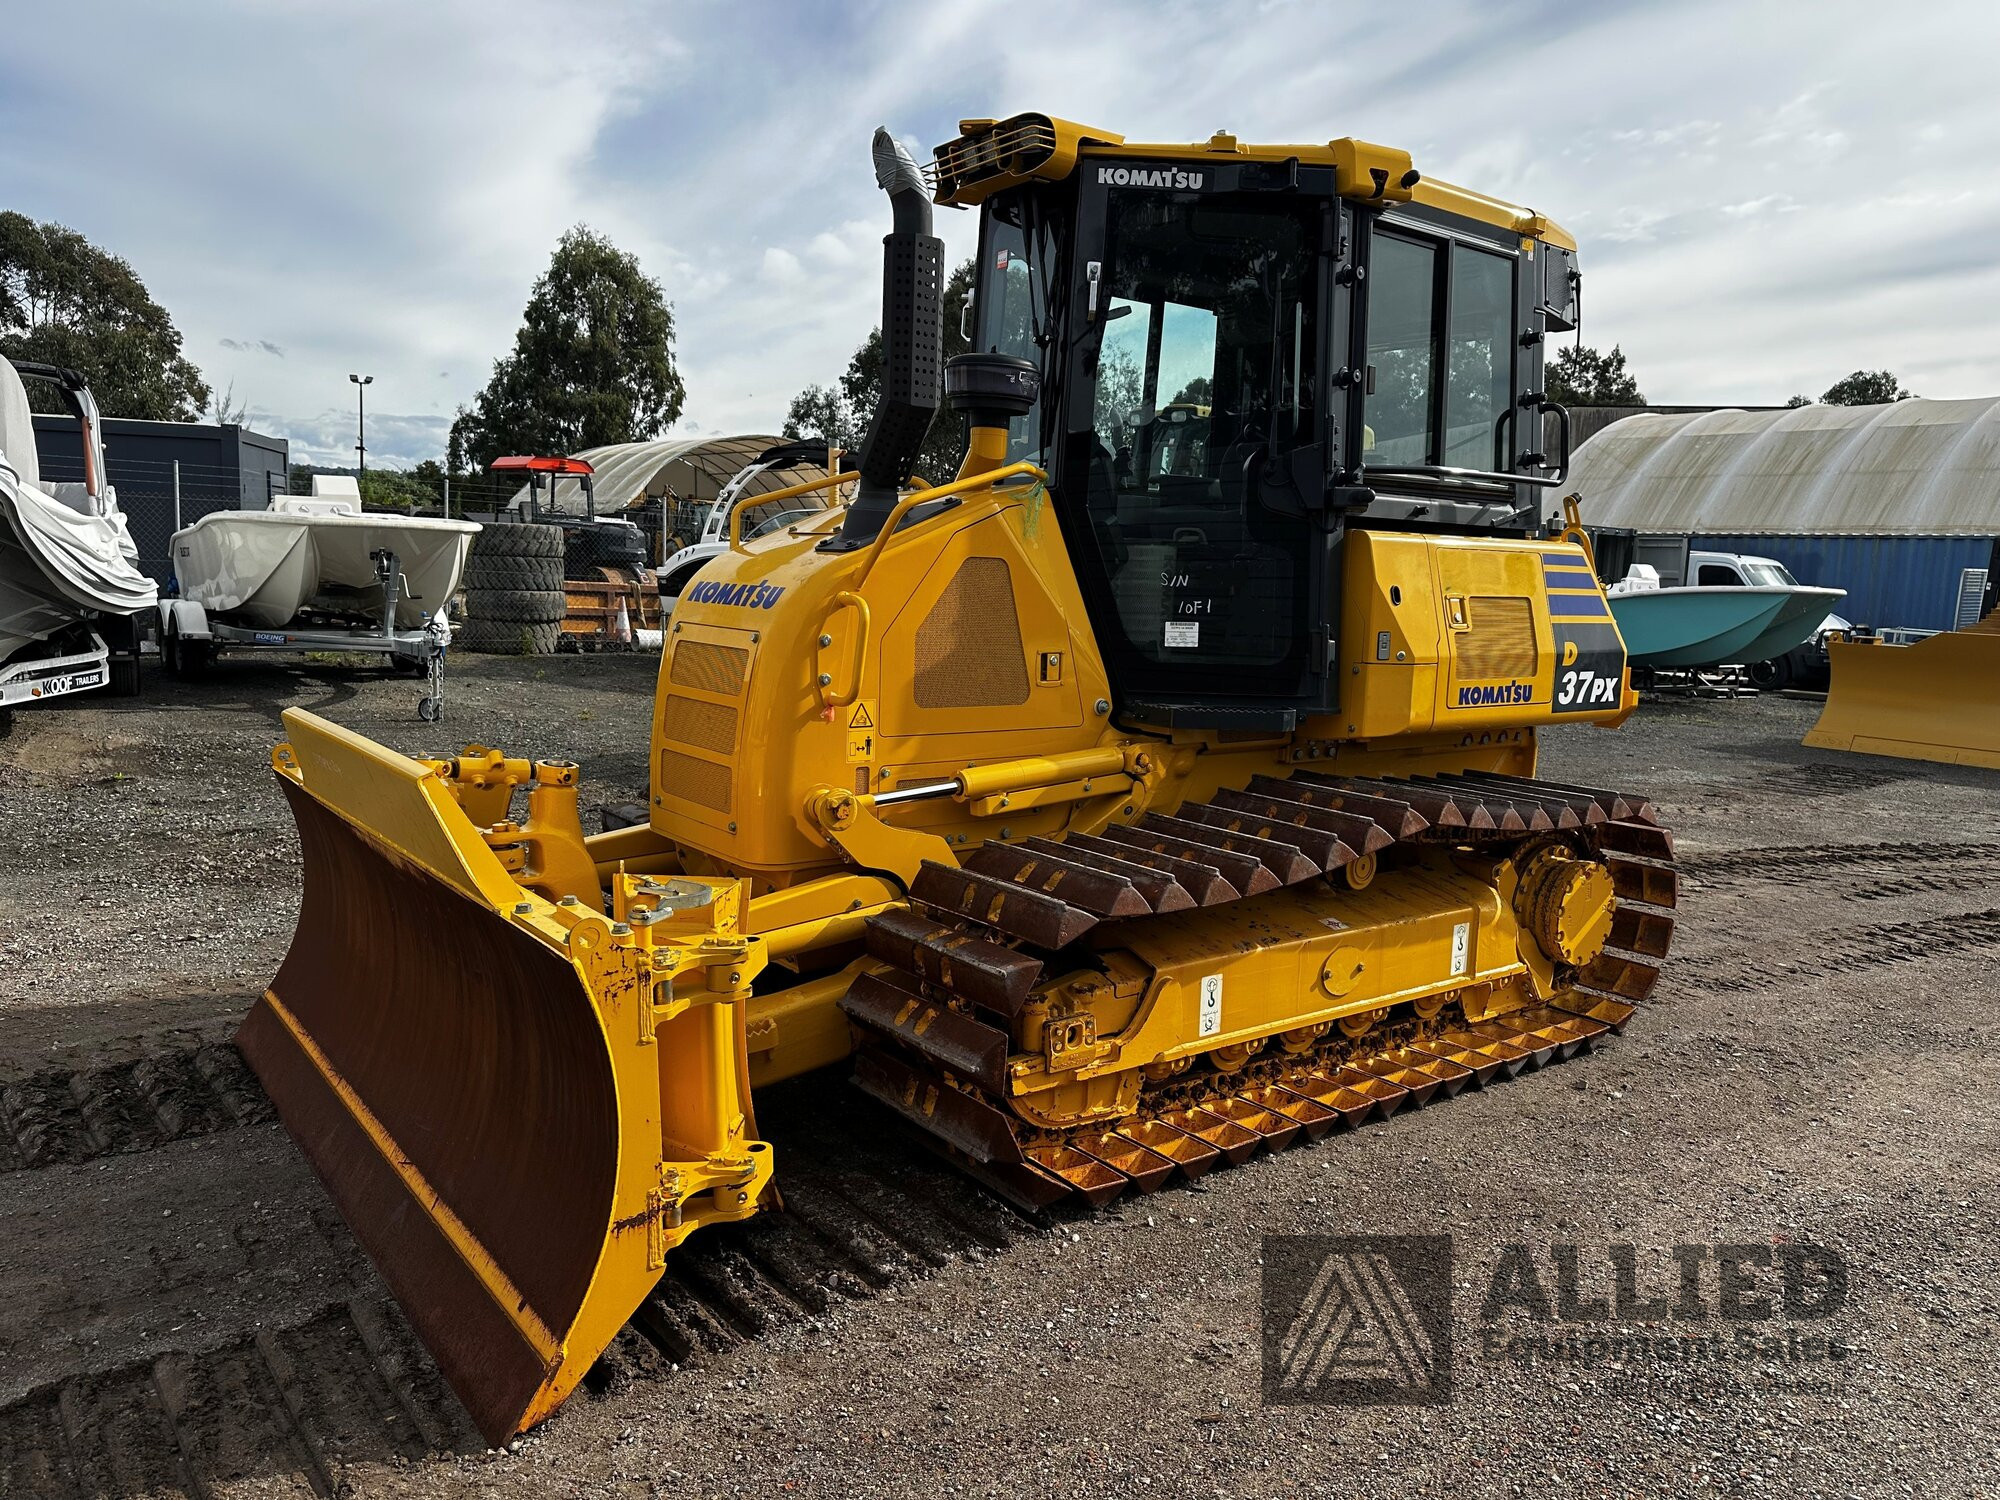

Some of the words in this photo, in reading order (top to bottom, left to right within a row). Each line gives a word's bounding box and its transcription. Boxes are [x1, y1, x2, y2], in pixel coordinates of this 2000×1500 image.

[1098, 167, 1203, 190] KOMATSU
[687, 580, 786, 610] KOMATSU
[255, 633, 286, 641] BOEING
[1562, 641, 1578, 666] D
[75, 674, 100, 687] TRAILERS
[1458, 680, 1533, 705] KOMATSU
[1558, 671, 1619, 705] 37PX
